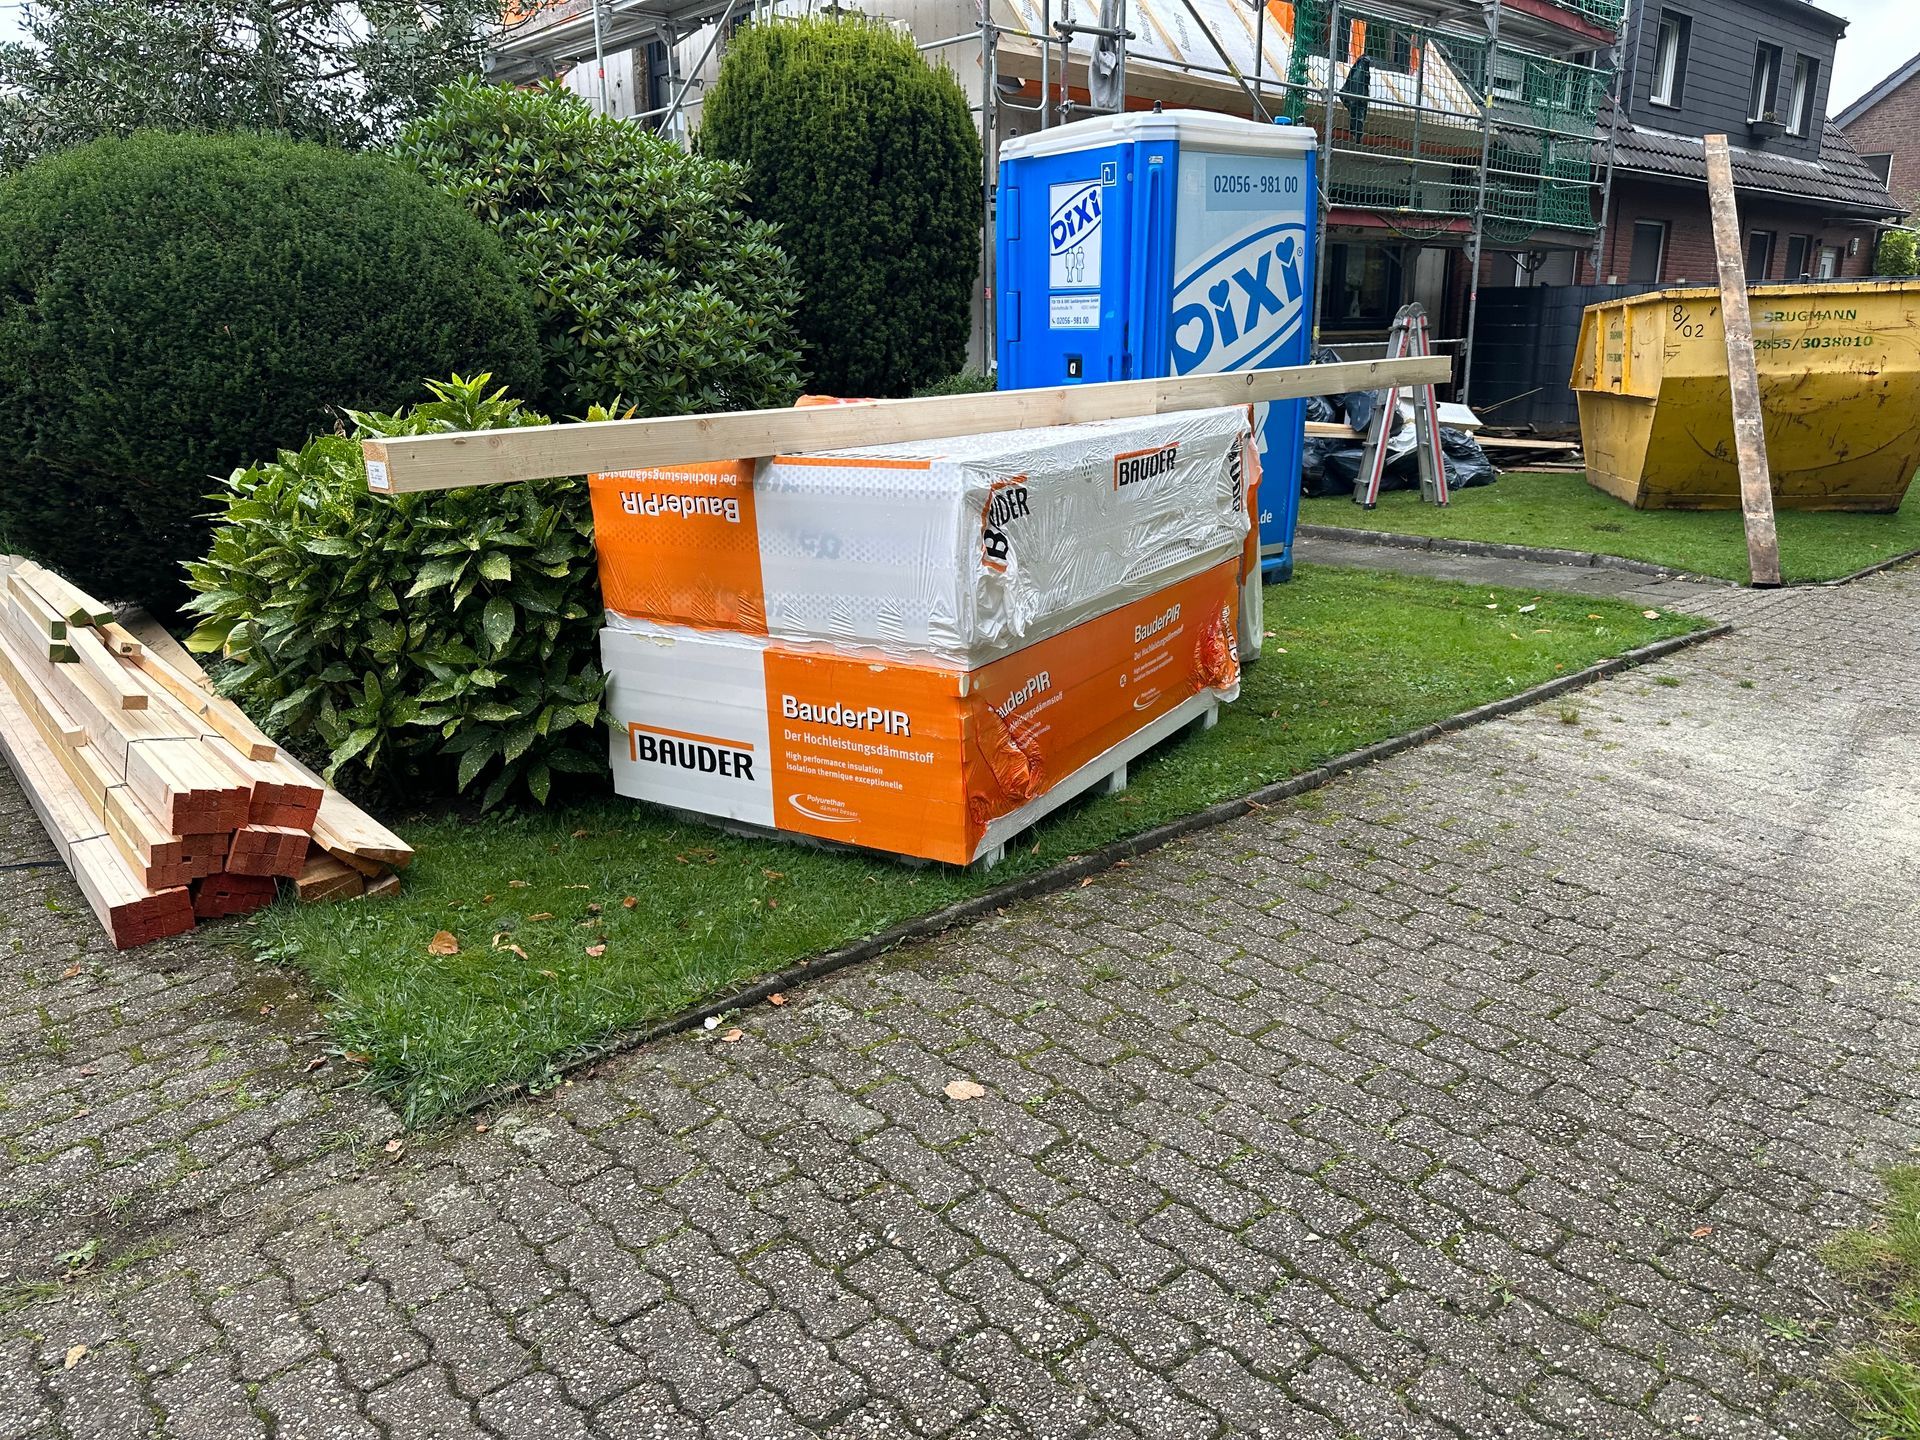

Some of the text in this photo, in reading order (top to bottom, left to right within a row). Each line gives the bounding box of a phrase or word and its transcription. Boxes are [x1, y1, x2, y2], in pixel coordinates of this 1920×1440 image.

[1214, 175, 1250, 193] 02056
[1260, 176, 1281, 193] 981
[1284, 176, 1298, 193] 00
[1753, 336, 1874, 351] 2855/3038010
[719, 473, 737, 486] Der
[1119, 448, 1177, 486] BAUDER
[620, 491, 740, 523] BauderPIR
[1135, 603, 1181, 645] BauderPIR
[996, 670, 1052, 719] auderPIR
[782, 694, 911, 737] BauderPIR
[638, 734, 755, 781] BAUDER
[784, 729, 935, 764] Der Hochleistungsdämmstoff
[785, 751, 883, 775] High performance insulation
[786, 762, 903, 790] Isolation thermique exceptionelle
[807, 794, 845, 808] Polyurethan
